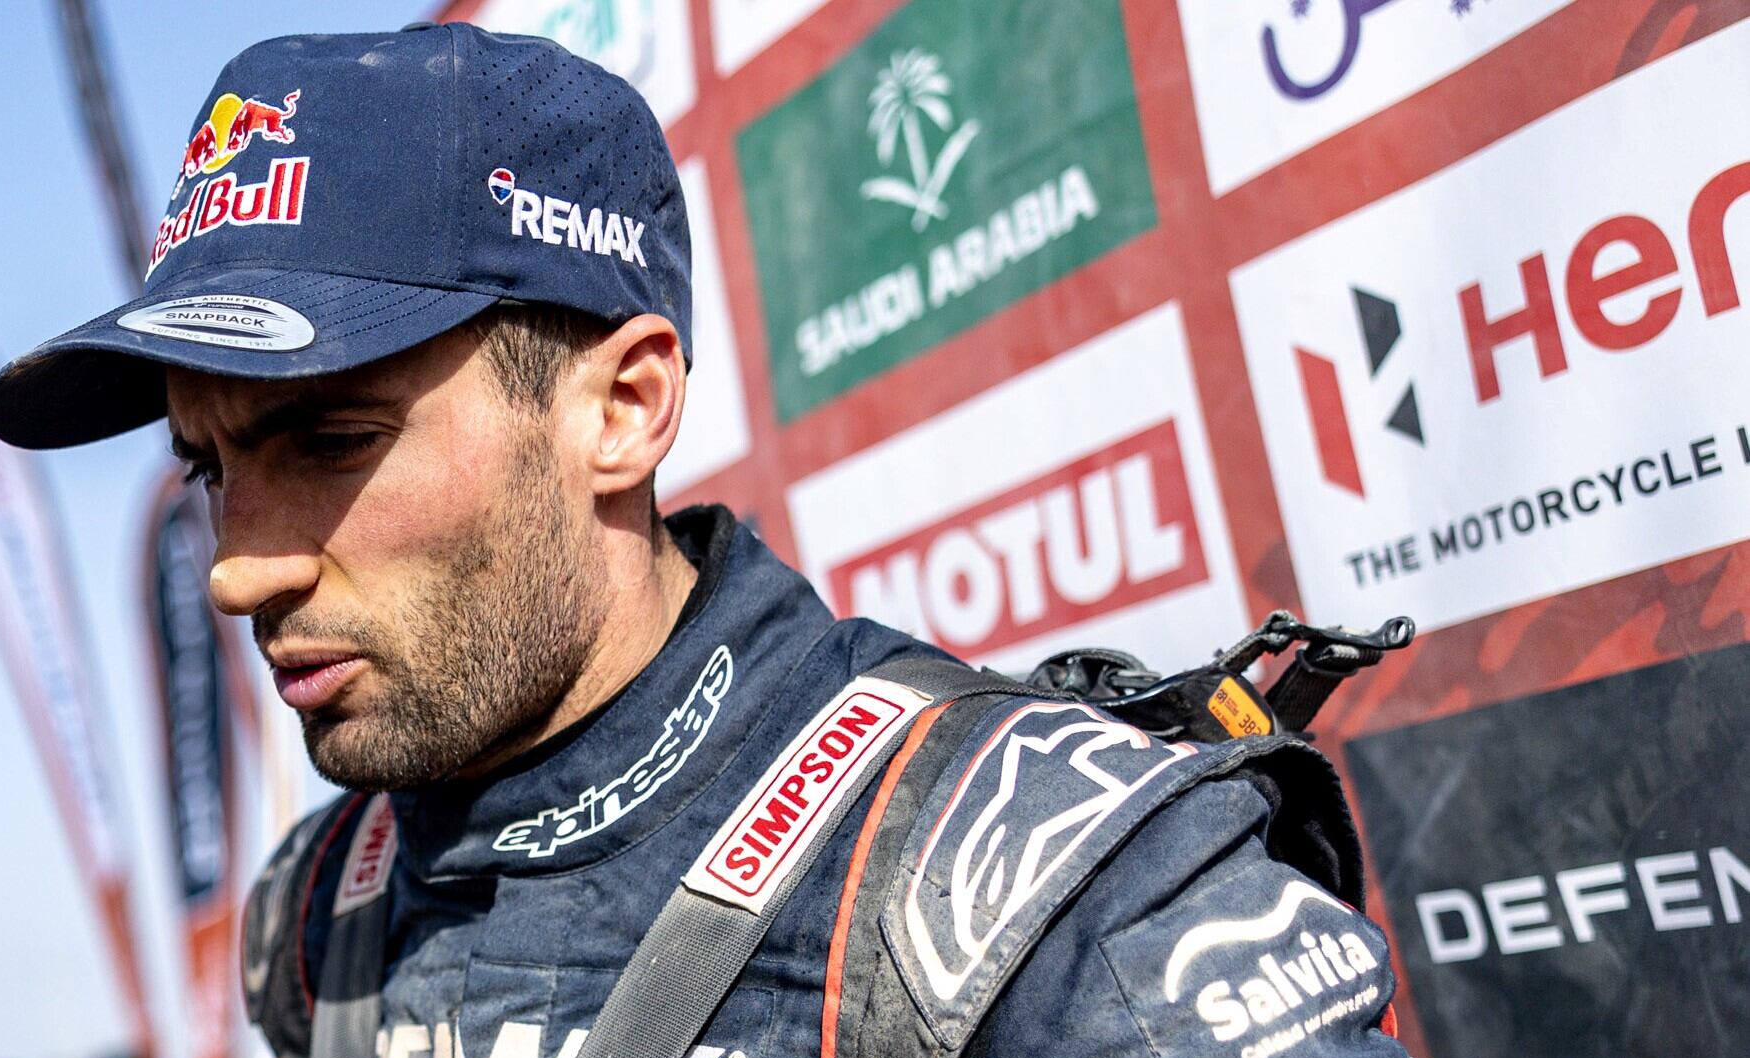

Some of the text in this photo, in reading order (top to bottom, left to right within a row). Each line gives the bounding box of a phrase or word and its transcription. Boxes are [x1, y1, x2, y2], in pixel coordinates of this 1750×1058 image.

[194, 157, 310, 237] Bull
[511, 188, 648, 268] REMAX
[202, 296, 270, 307] AUTHENTIC
[796, 165, 1099, 377] SAUDI ARABIA
[151, 327, 200, 340] YUPOONG
[209, 336, 239, 346] SINCE
[165, 312, 266, 328] SNAPBACK
[854, 454, 1184, 646] MOTUL
[1345, 536, 1421, 588] THE
[1429, 434, 1723, 564] MOTORCYCLE
[725, 705, 881, 881] SIMPSON
[1196, 932, 1378, 1042] Salvita
